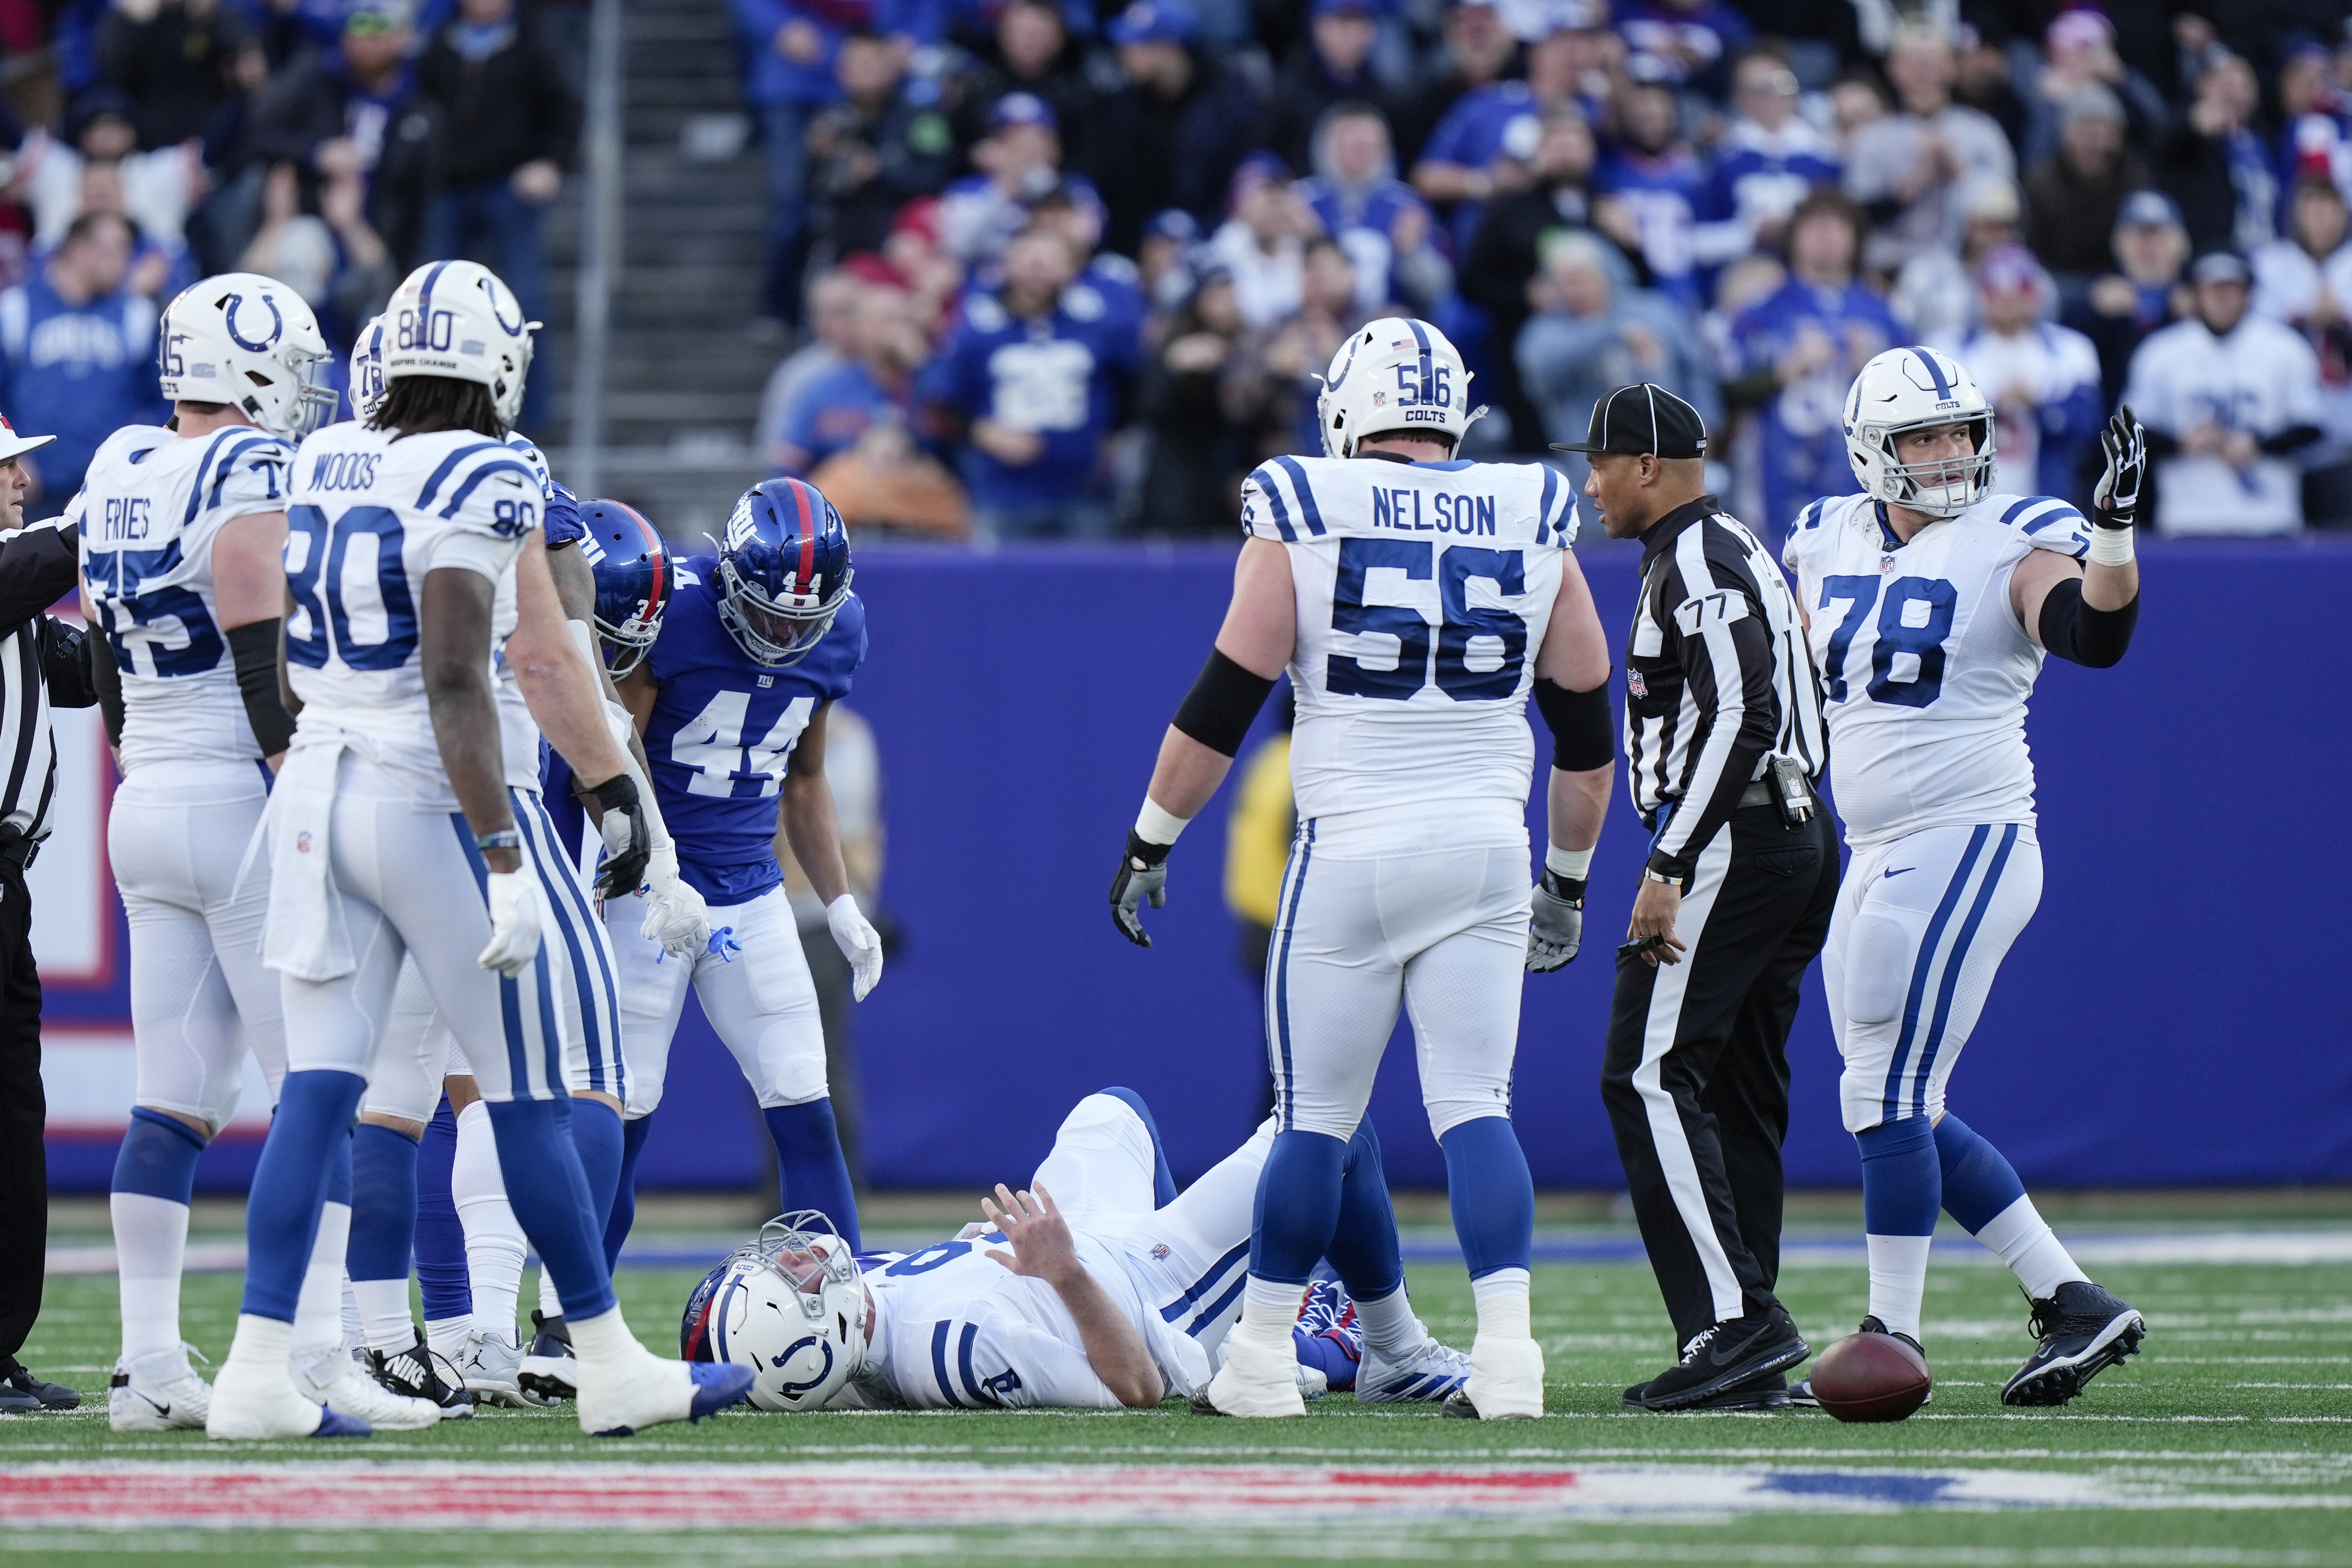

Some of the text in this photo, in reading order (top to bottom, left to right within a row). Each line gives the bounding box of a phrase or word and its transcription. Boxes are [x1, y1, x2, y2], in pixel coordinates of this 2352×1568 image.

[399, 310, 452, 352] 80
[1398, 365, 1450, 408] 56
[1405, 411, 1446, 423] COLTS
[1936, 401, 1960, 411] COLTS
[307, 453, 382, 491] WOODS
[106, 498, 151, 541] FRIES
[1372, 486, 1495, 536] NELSON
[283, 504, 419, 671] 80
[783, 571, 822, 594] 44
[631, 599, 666, 620] 37
[1326, 537, 1528, 701] 56
[1684, 592, 1727, 628] 77
[1818, 574, 1958, 708] 78
[1630, 681, 1646, 694] NFL
[671, 689, 815, 798] 44
[1157, 1245, 1169, 1255] NFL
[384, 1353, 426, 1390] NIKE
